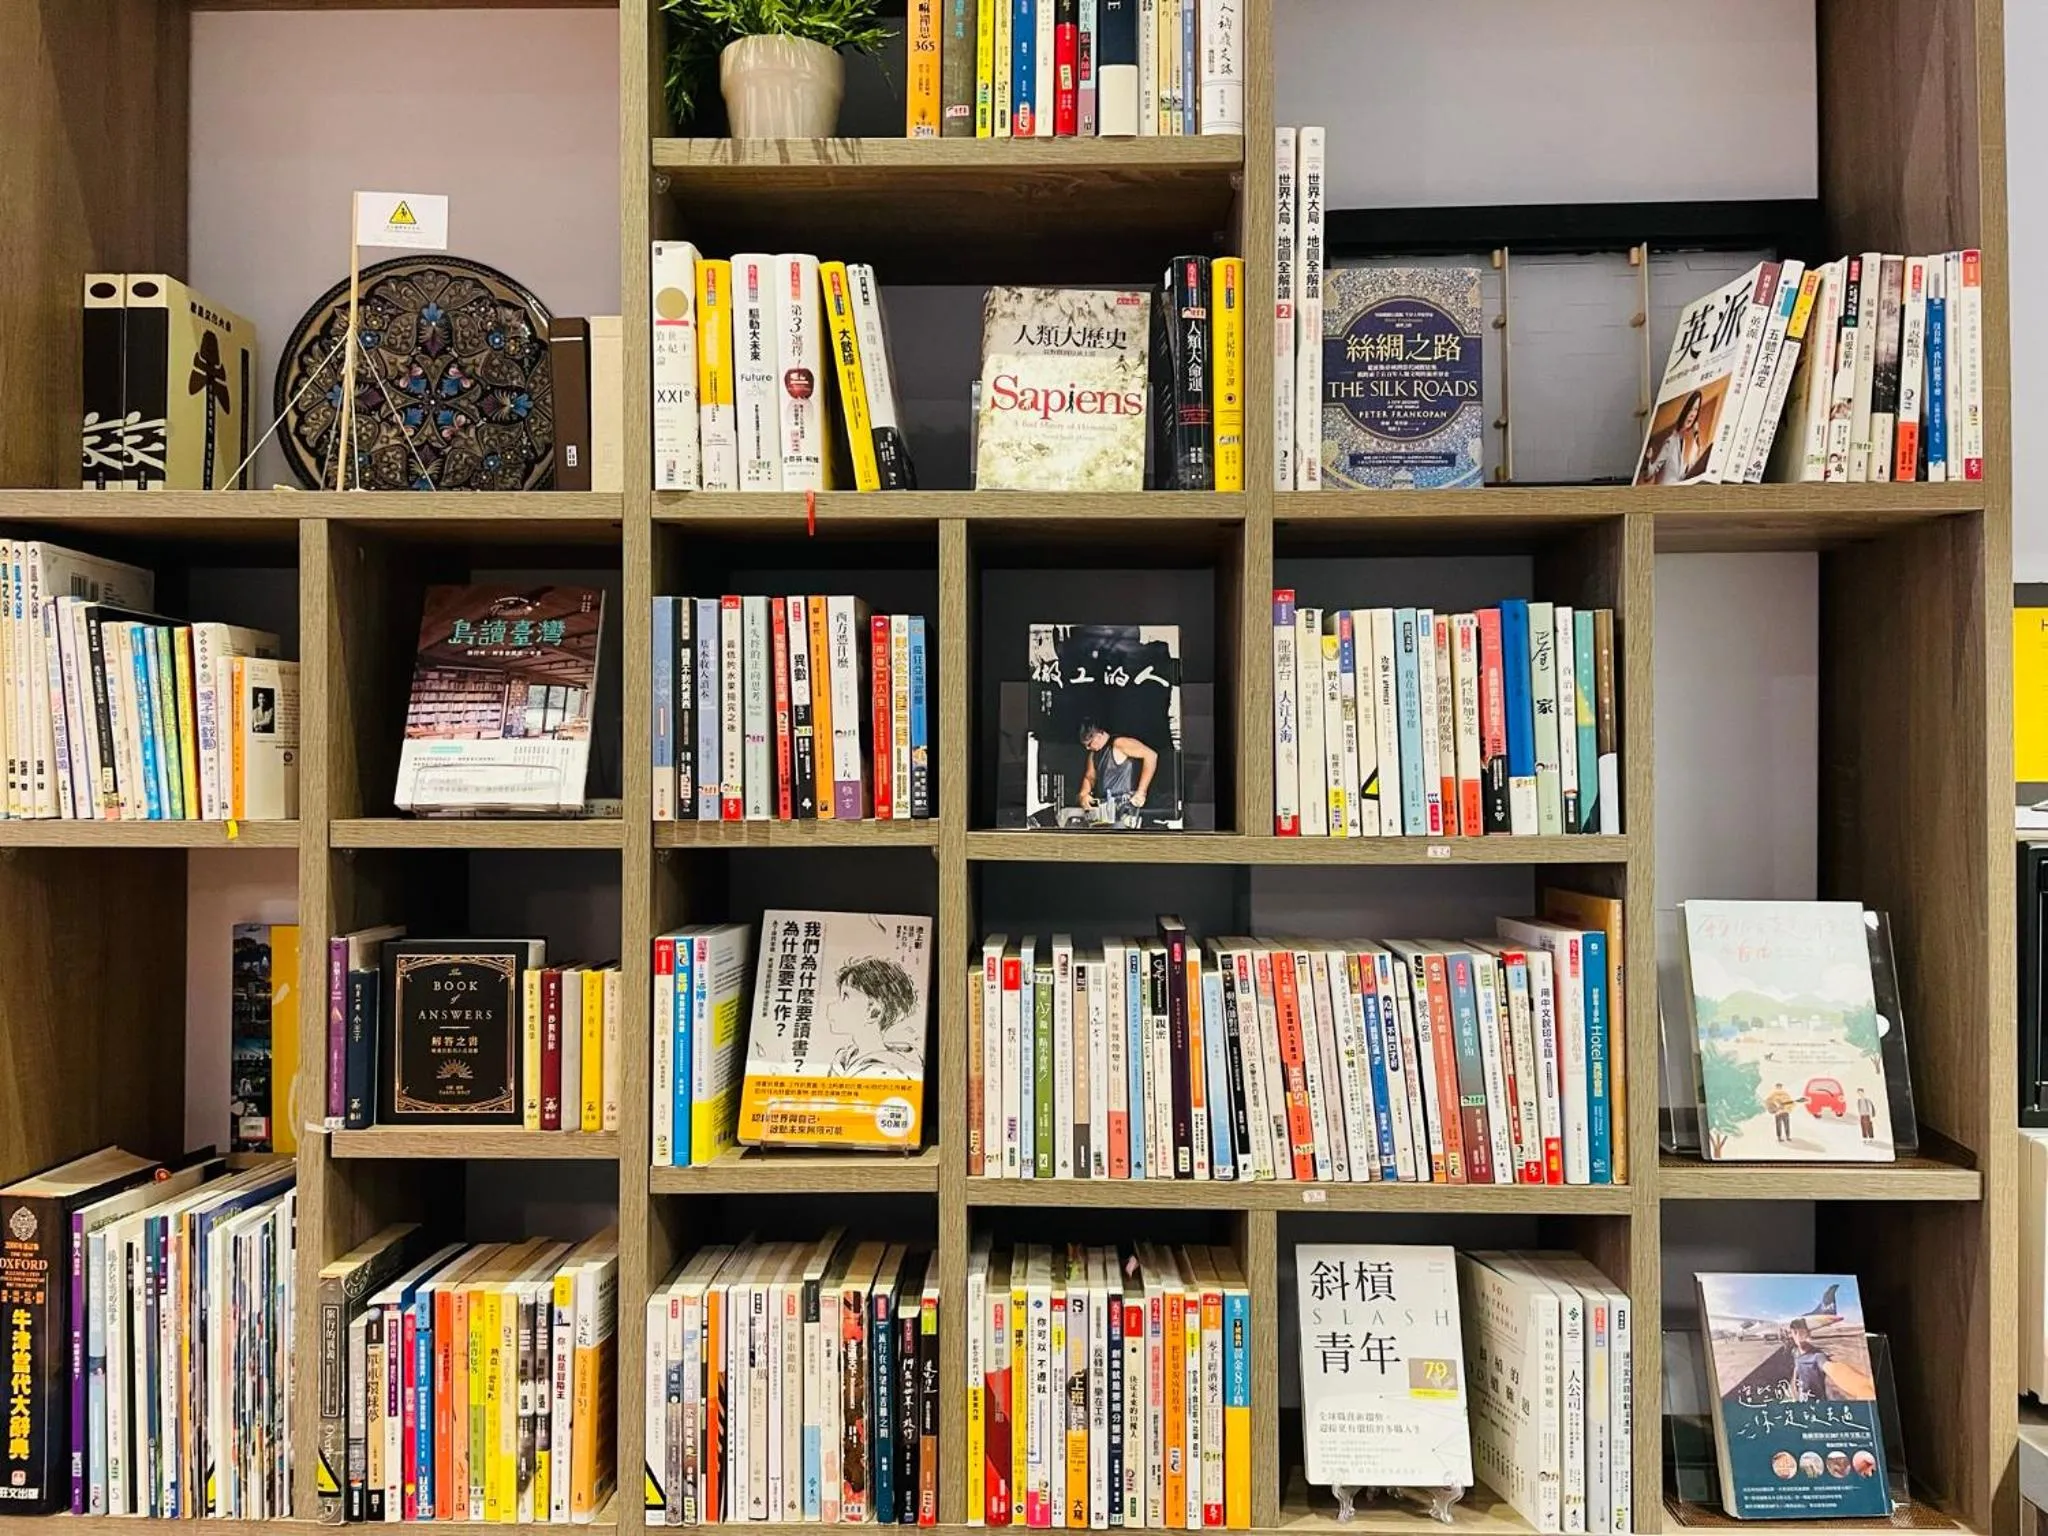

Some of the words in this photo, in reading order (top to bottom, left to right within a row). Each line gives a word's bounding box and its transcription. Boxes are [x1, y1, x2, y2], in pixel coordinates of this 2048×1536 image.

[913, 40, 935, 52] 365
[1277, 305, 1290, 318] 2
[1670, 280, 1754, 373] 英派
[839, 328, 856, 367] 大數據
[1014, 324, 1128, 350] 人類大歷史
[1346, 333, 1462, 363] 絲綢之路
[1187, 320, 1203, 392] 人類大命運
[1755, 328, 1781, 389] 五體不滿足
[990, 374, 1144, 420] Sapiens
[1327, 381, 1365, 398] THE
[1370, 380, 1409, 398] SILK
[1413, 380, 1478, 402] ROADS
[1359, 410, 1388, 418] PETER
[448, 617, 566, 647] 島讀臺灣
[793, 653, 807, 682] 異數
[1032, 660, 1170, 689] 做工的人
[1278, 639, 1292, 681] 龍應台
[1327, 670, 1338, 701] 野火集
[1536, 698, 1554, 715] 家
[433, 981, 478, 991] BOOK
[774, 920, 800, 1037] 為什麼要工作?
[418, 1009, 493, 1020] ANSWERS
[431, 1036, 478, 1047] 解答之書
[1590, 1024, 1603, 1060] Hotel
[1289, 1067, 1306, 1109] MESSY
[0, 1257, 48, 1271] OXFORD
[1310, 1260, 1397, 1302] 斜槓
[1312, 1309, 1450, 1326] SLASH
[1314, 1332, 1401, 1375] 青年
[9, 1309, 32, 1461] 牛津當代大辭典
[1422, 1361, 1449, 1381] 79
